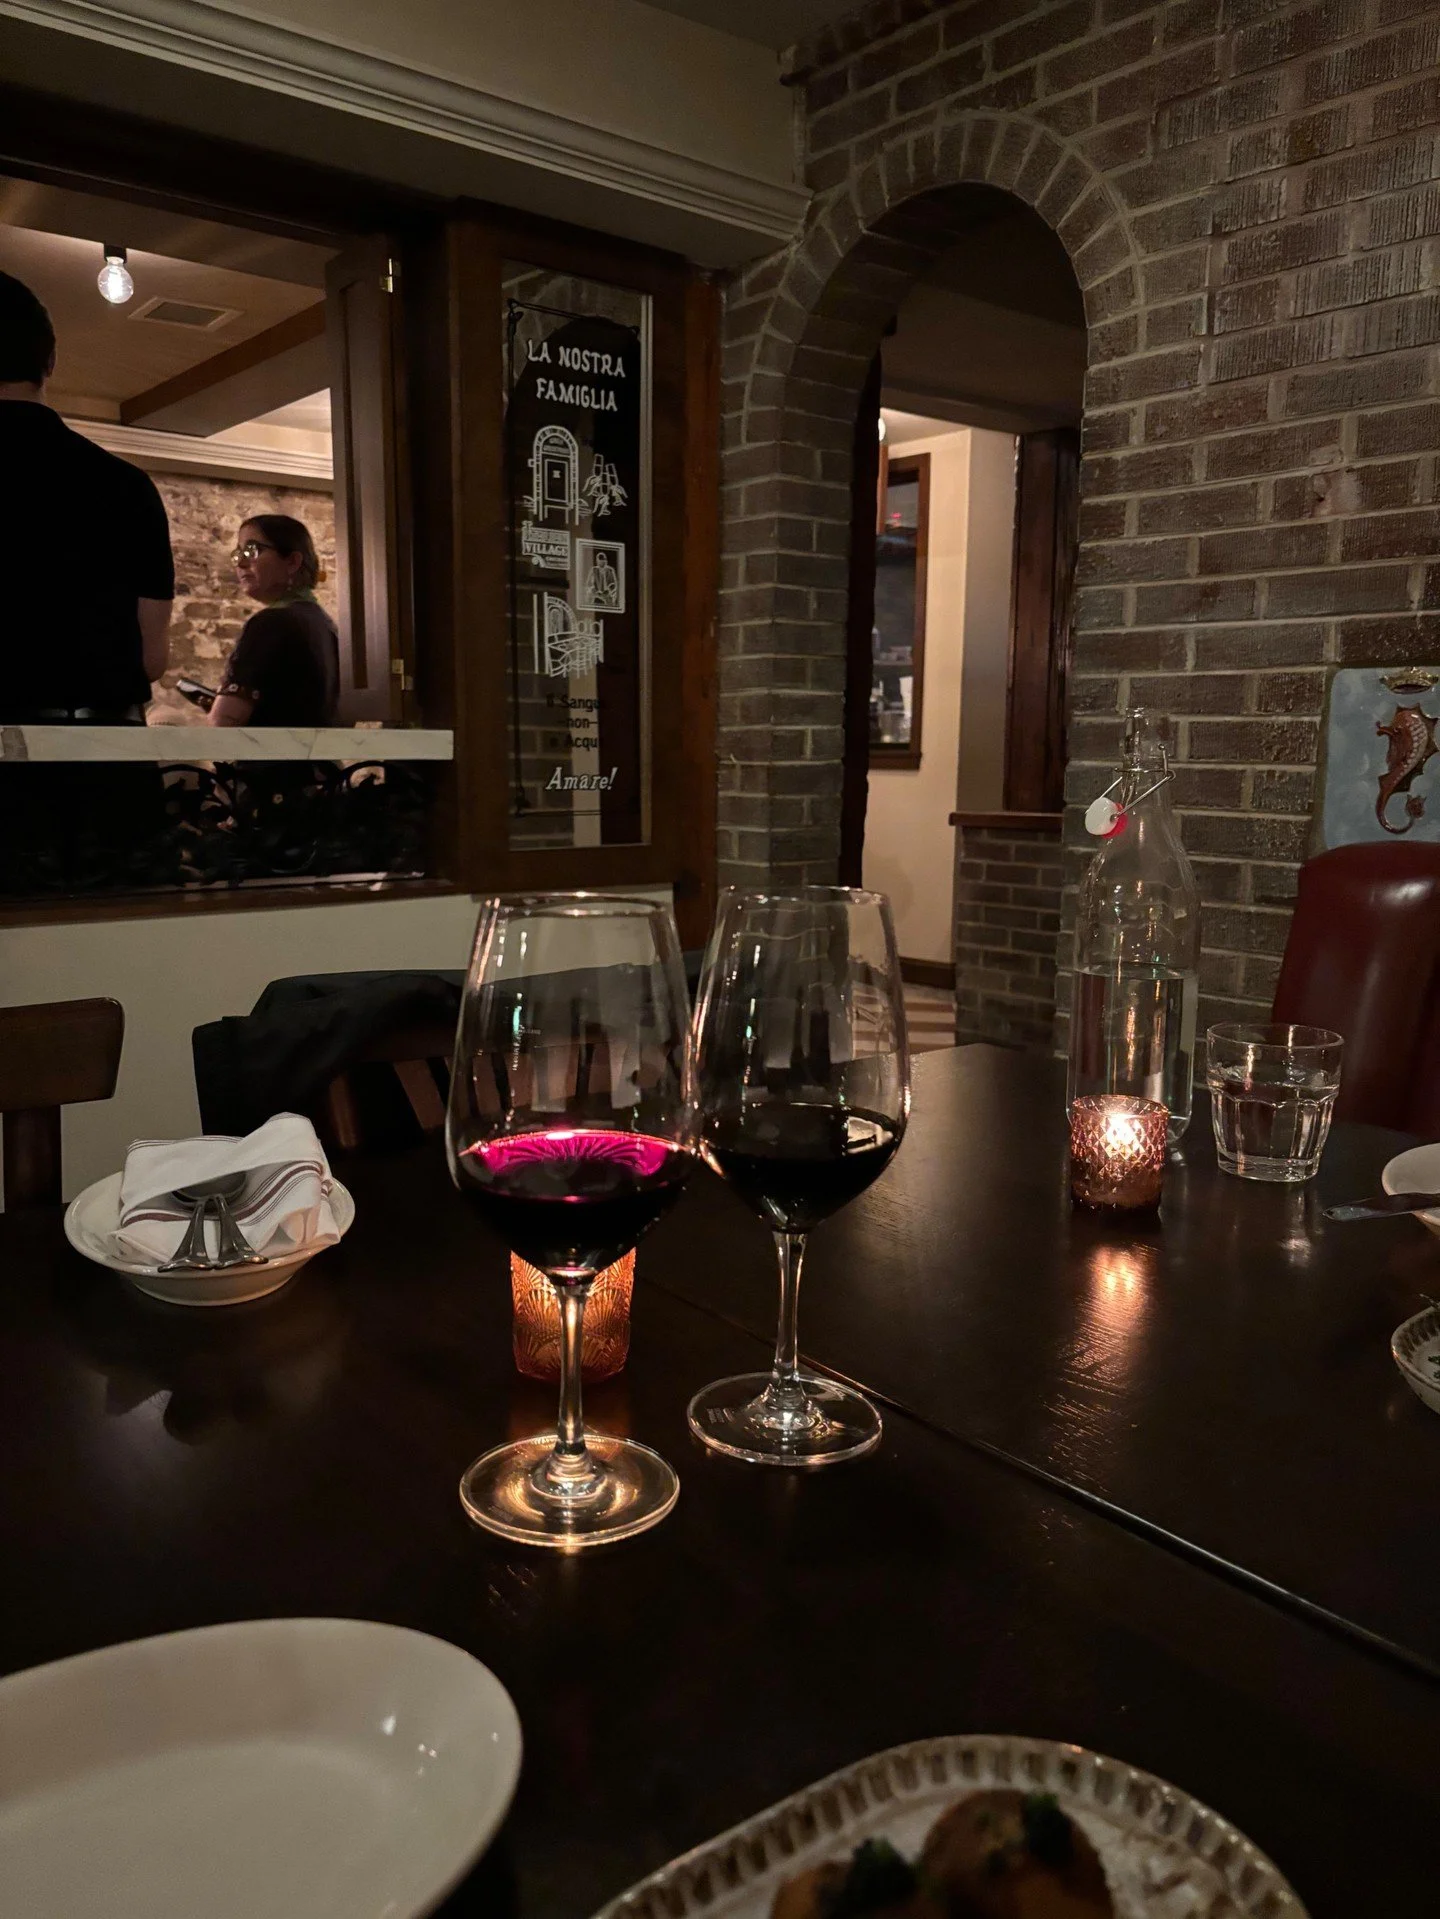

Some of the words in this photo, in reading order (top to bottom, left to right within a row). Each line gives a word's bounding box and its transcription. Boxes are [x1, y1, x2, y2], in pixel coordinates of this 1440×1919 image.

[527, 339, 551, 364] LA
[558, 345, 626, 378] NOSTRA
[536, 377, 618, 412] FAMIGLIA
[525, 543, 568, 557] VILLAGE
[560, 694, 604, 712] Sangu
[565, 734, 603, 751] Acqu
[545, 766, 618, 791] Amare!
